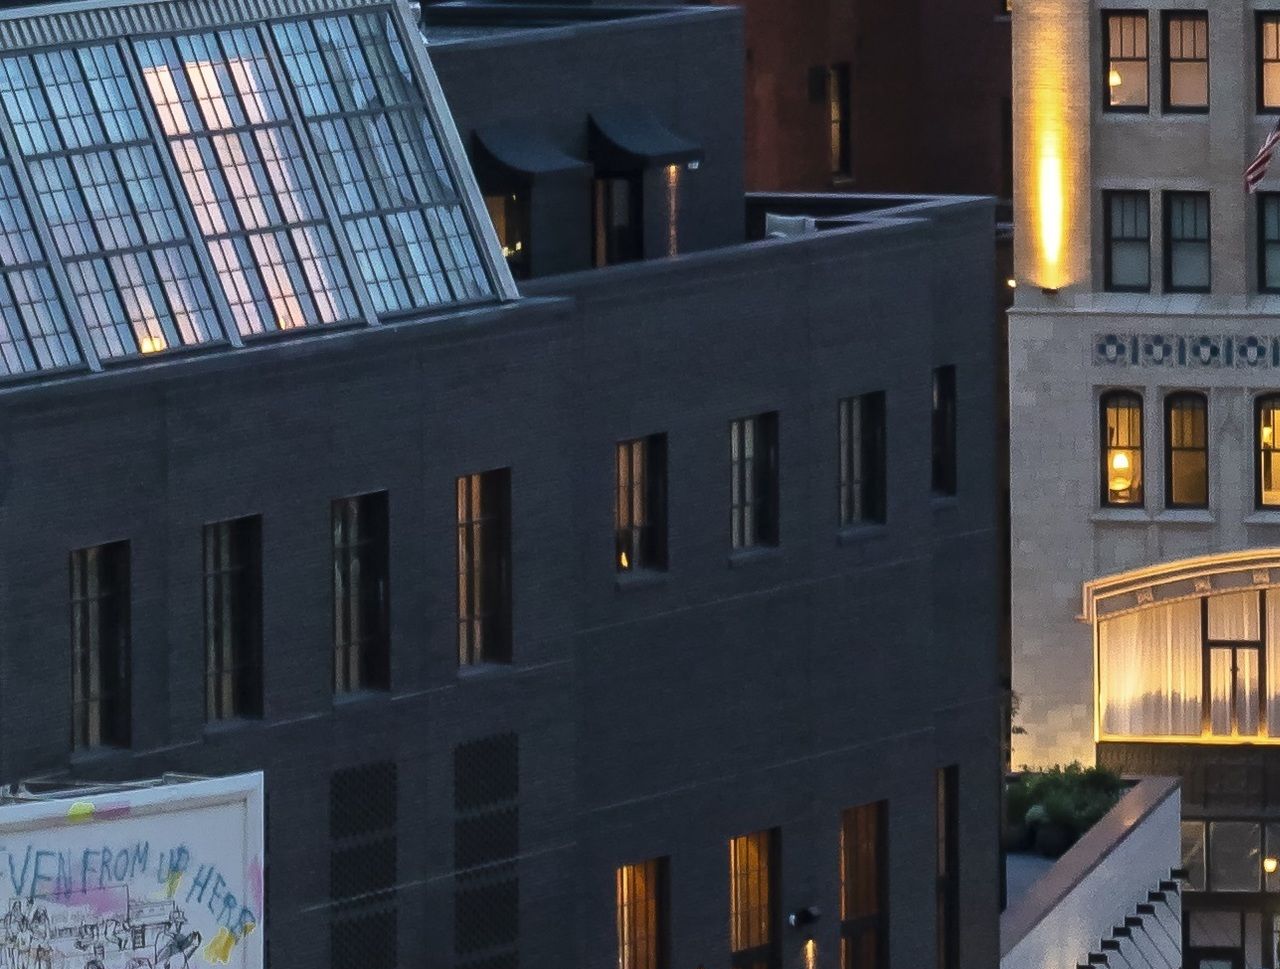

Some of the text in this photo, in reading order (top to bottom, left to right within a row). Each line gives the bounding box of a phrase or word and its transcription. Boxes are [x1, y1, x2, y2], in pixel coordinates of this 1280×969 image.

[0, 845, 72, 898] VEN
[82, 840, 149, 894] FROM
[157, 844, 191, 884] UP
